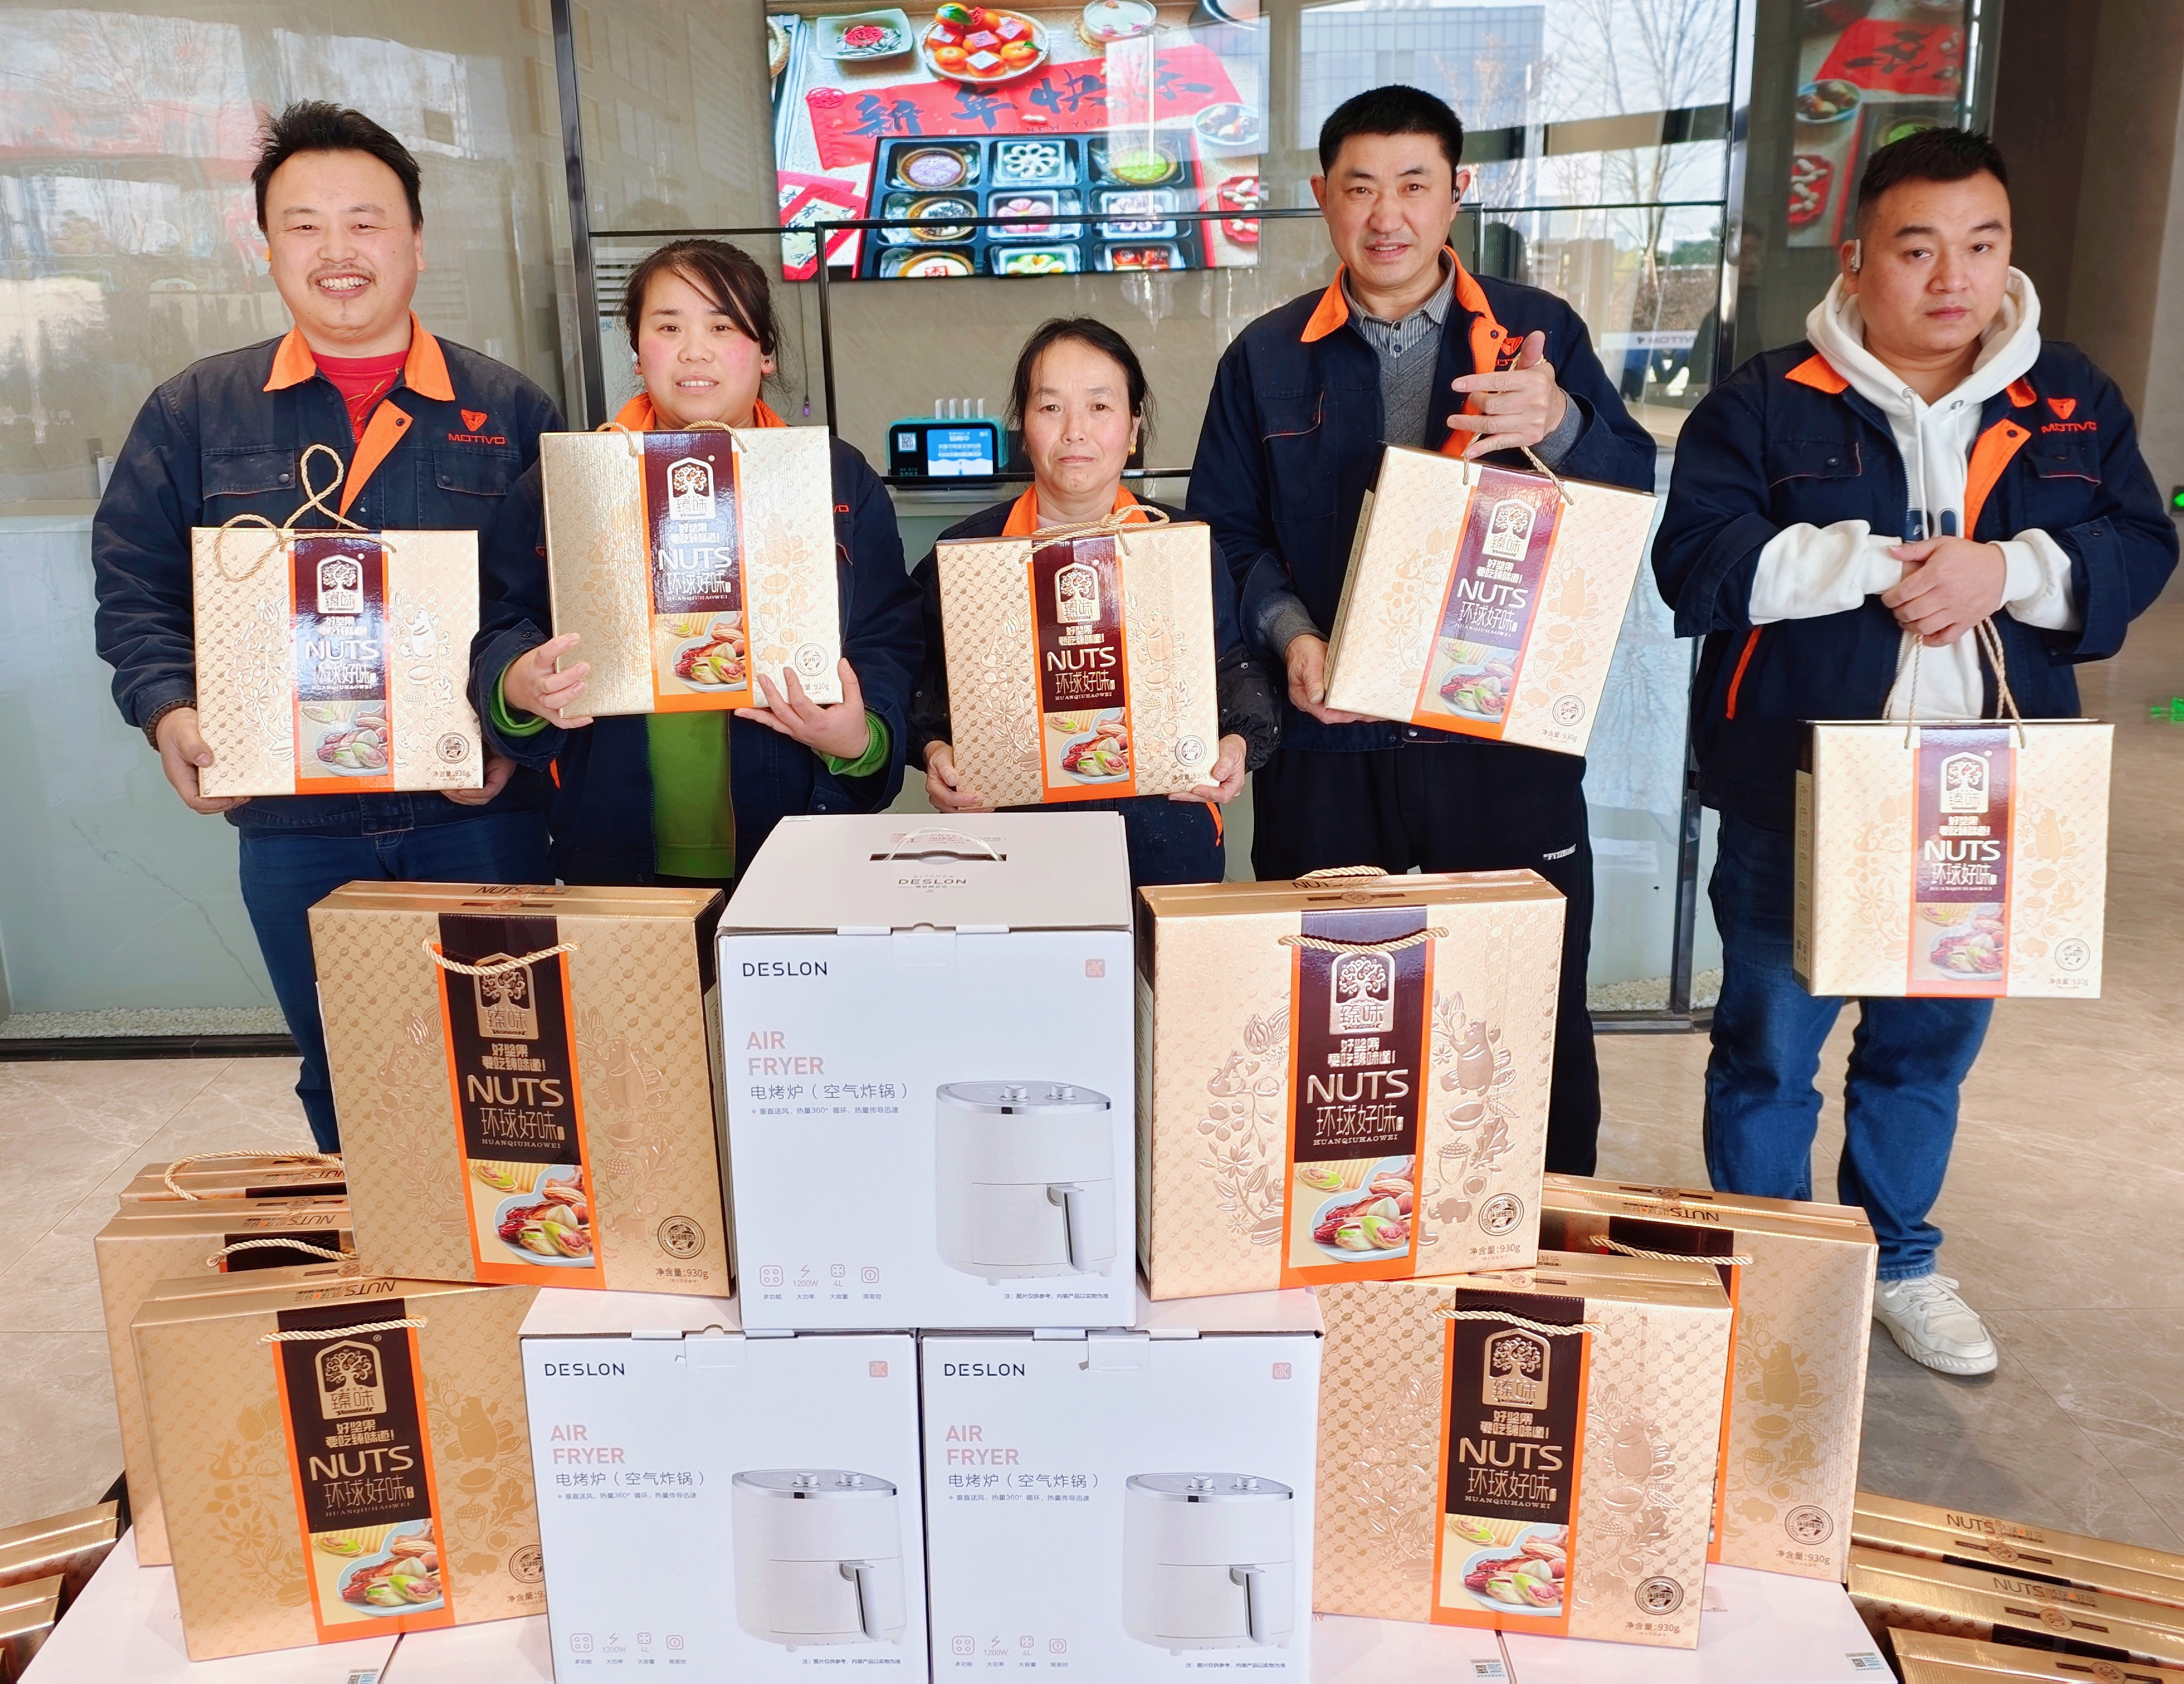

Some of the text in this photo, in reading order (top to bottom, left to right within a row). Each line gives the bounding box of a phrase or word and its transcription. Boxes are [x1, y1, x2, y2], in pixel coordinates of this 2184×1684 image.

[2041, 421, 2097, 433] MOTIVO
[448, 433, 506, 445] MOTIVO
[677, 499, 707, 512] 臻味
[1491, 536, 1521, 553] 臻味
[658, 547, 733, 570] NUTS
[1487, 558, 1515, 573] 好坚果
[667, 572, 726, 594] 环球好味
[1457, 578, 1529, 609] NUTS
[1063, 602, 1093, 617] 臻味
[1458, 601, 1516, 632] 环球好味
[306, 640, 379, 661] NUTS
[1047, 646, 1116, 672] NUTS
[1055, 670, 1110, 694] 环球好味
[1924, 840, 2001, 861] NUTS
[475, 886, 522, 894] NUTS
[742, 961, 828, 977] DESLON
[487, 1010, 528, 1030] 臻味
[1339, 1005, 1384, 1024] 臻味
[746, 1031, 786, 1050] AIR
[1341, 1038, 1380, 1053] 好坚果
[492, 1043, 528, 1058] 好坚果
[482, 1056, 546, 1072] 要吃臻味道!
[748, 1056, 824, 1076] FRYER
[467, 1075, 564, 1107] NUTS
[1307, 1069, 1409, 1104] NUTS
[479, 1107, 558, 1140] 环球好味
[1316, 1102, 1397, 1137] 环球好味
[482, 1139, 562, 1149] HUANQIUHAOWEI
[1313, 1134, 1399, 1146] HUANQIUHAOWEI
[287, 1214, 336, 1225] NUTS
[1670, 1207, 1719, 1222] NUTS
[1469, 1243, 1521, 1256] 净含量:930g
[655, 1267, 709, 1280] 净含量:930g
[344, 1280, 396, 1297] NUTS
[544, 1363, 625, 1376] DESLON
[944, 1363, 1026, 1377] DESLON
[1493, 1380, 1536, 1399] 臻味
[330, 1389, 374, 1410] 臻味
[1493, 1410, 1533, 1425] 好坚果
[336, 1419, 376, 1434] 好坚果
[550, 1424, 588, 1441] AIR
[945, 1425, 984, 1442] AIR
[1480, 1421, 1549, 1439] 要吃臻味道!
[325, 1429, 395, 1448] 要吃臻味道!
[553, 1448, 625, 1465] FRYER
[947, 1449, 1020, 1466] FRYER
[1459, 1437, 1563, 1471] NUTS
[309, 1445, 414, 1481] NUTS
[323, 1475, 406, 1509] 环球好味
[1467, 1467, 1549, 1501] 环球好味
[1465, 1495, 1551, 1509] HUANQIUHAOWEI
[1946, 1514, 1995, 1534] NUTS
[1775, 1549, 1831, 1565] 净含量:930g
[1993, 1577, 2045, 1598] NUTS
[1624, 1622, 1680, 1634] 净含量:930g
